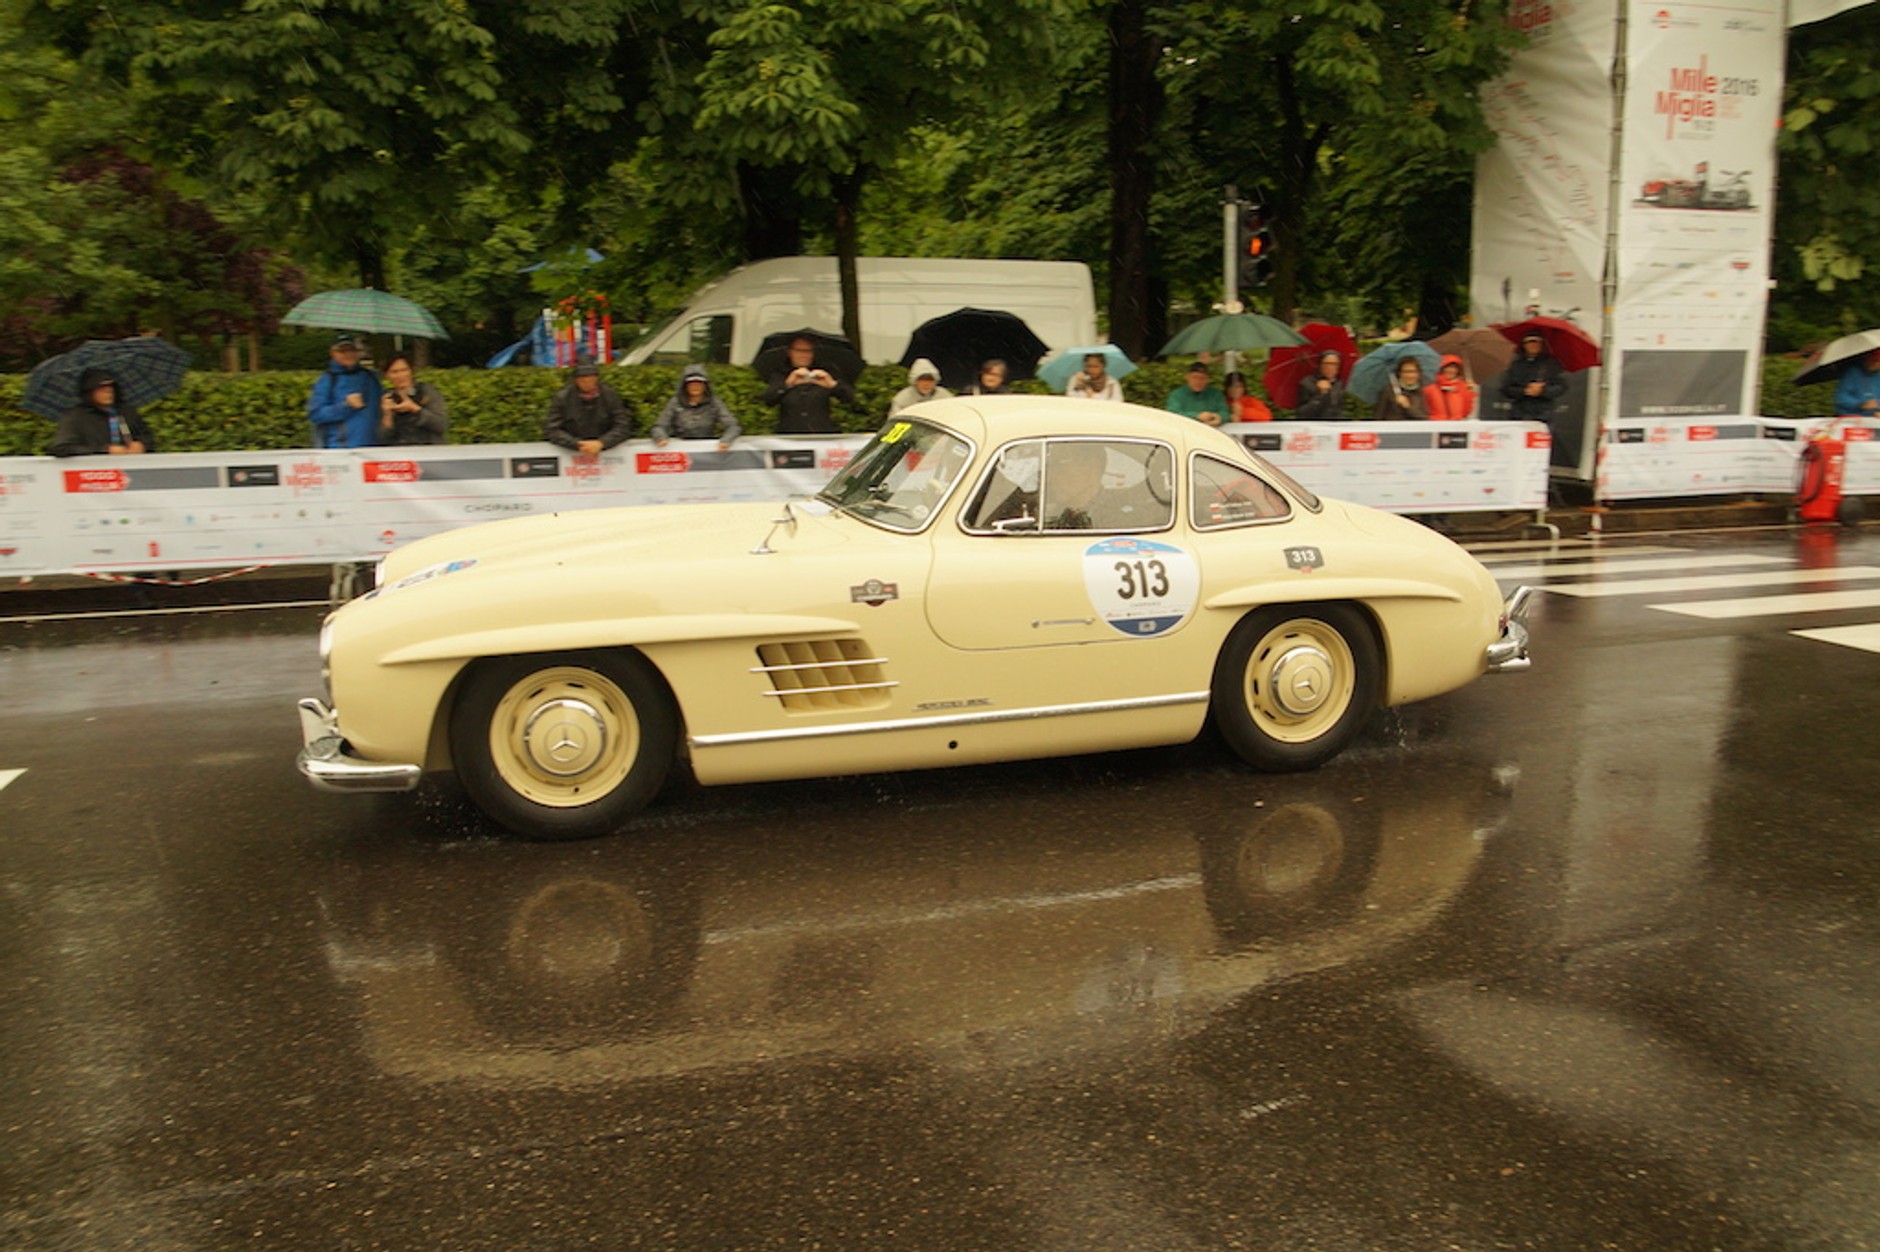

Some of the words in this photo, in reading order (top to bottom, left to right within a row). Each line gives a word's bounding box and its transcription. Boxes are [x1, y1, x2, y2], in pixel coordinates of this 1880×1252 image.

[1670, 54, 1718, 93] Mille
[1721, 77, 1759, 96] 2016
[1655, 91, 1716, 140] Miglia
[1291, 550, 1316, 563] 313
[1114, 559, 1169, 600] 313
